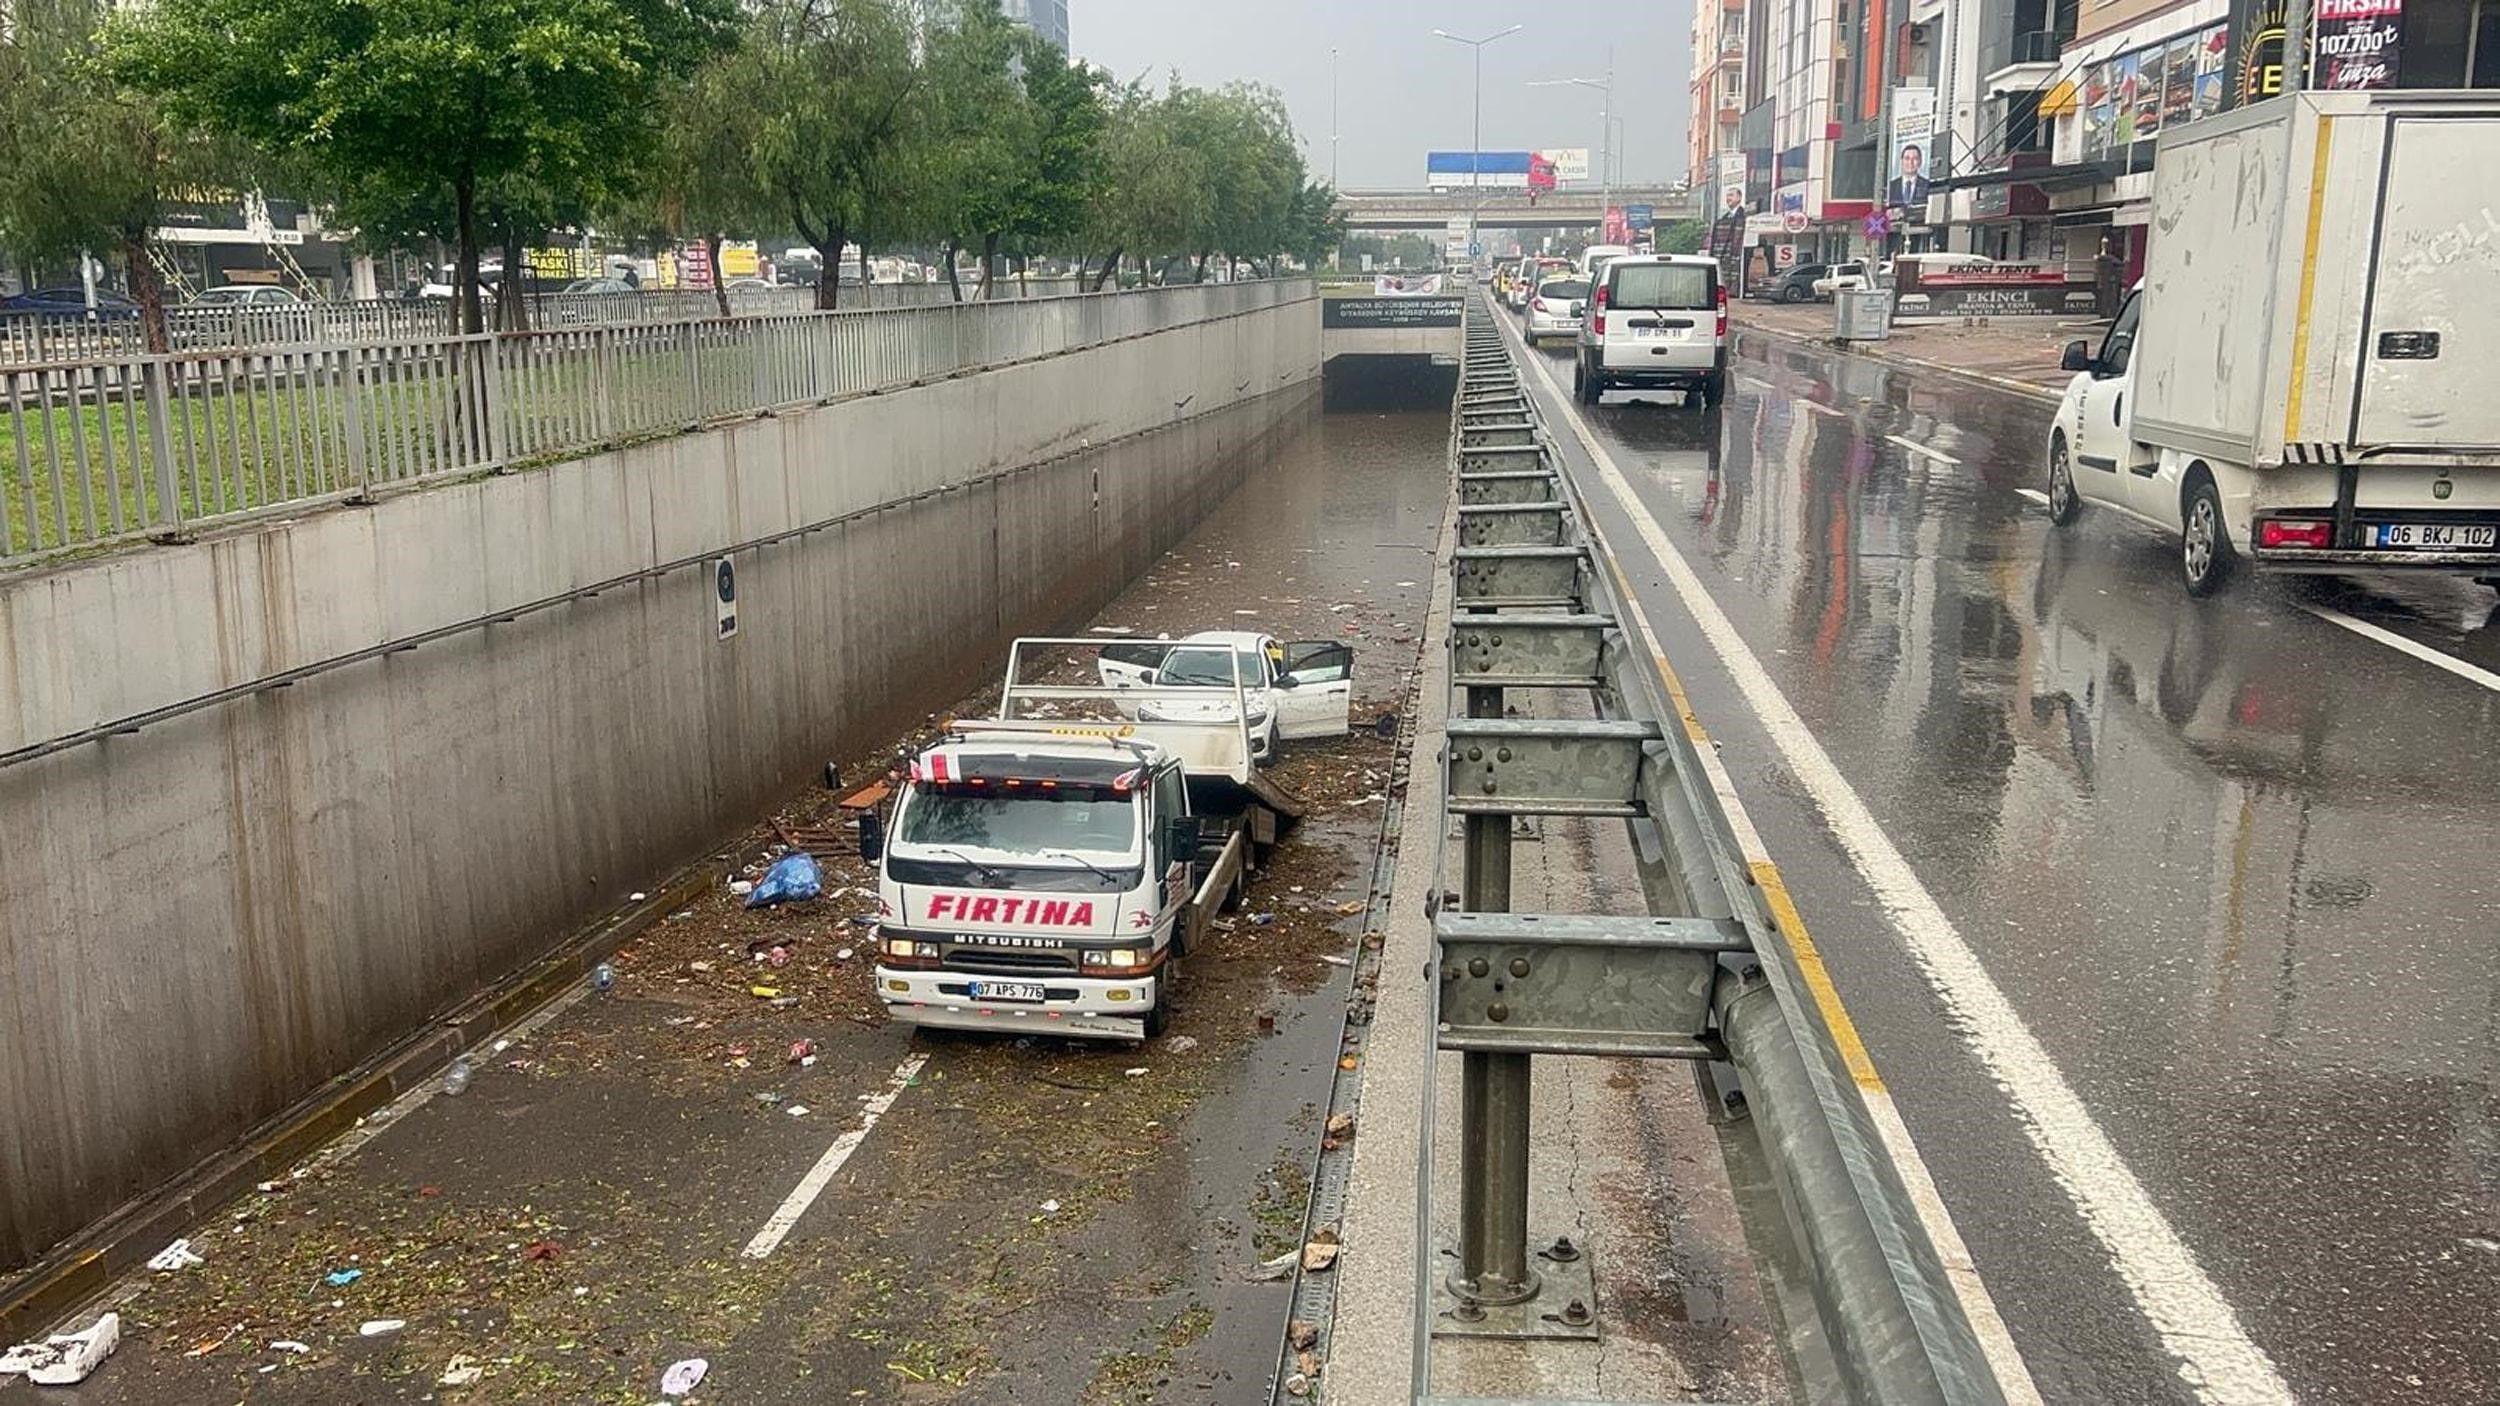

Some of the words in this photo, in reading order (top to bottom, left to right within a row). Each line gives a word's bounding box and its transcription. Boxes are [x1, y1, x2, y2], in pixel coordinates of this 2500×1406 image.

[1997, 264, 2040, 274] TENTE
[1967, 290, 2029, 303] EKİNCİ
[2391, 527, 2411, 543] 06
[2422, 527, 2454, 544] BKJ
[2463, 527, 2492, 544] 102
[927, 894, 1093, 927] FIRTINA
[954, 934, 1063, 948] MITSUBISHI
[977, 983, 991, 996] 07
[995, 983, 1016, 997] APS
[1022, 984, 1044, 998] 776
